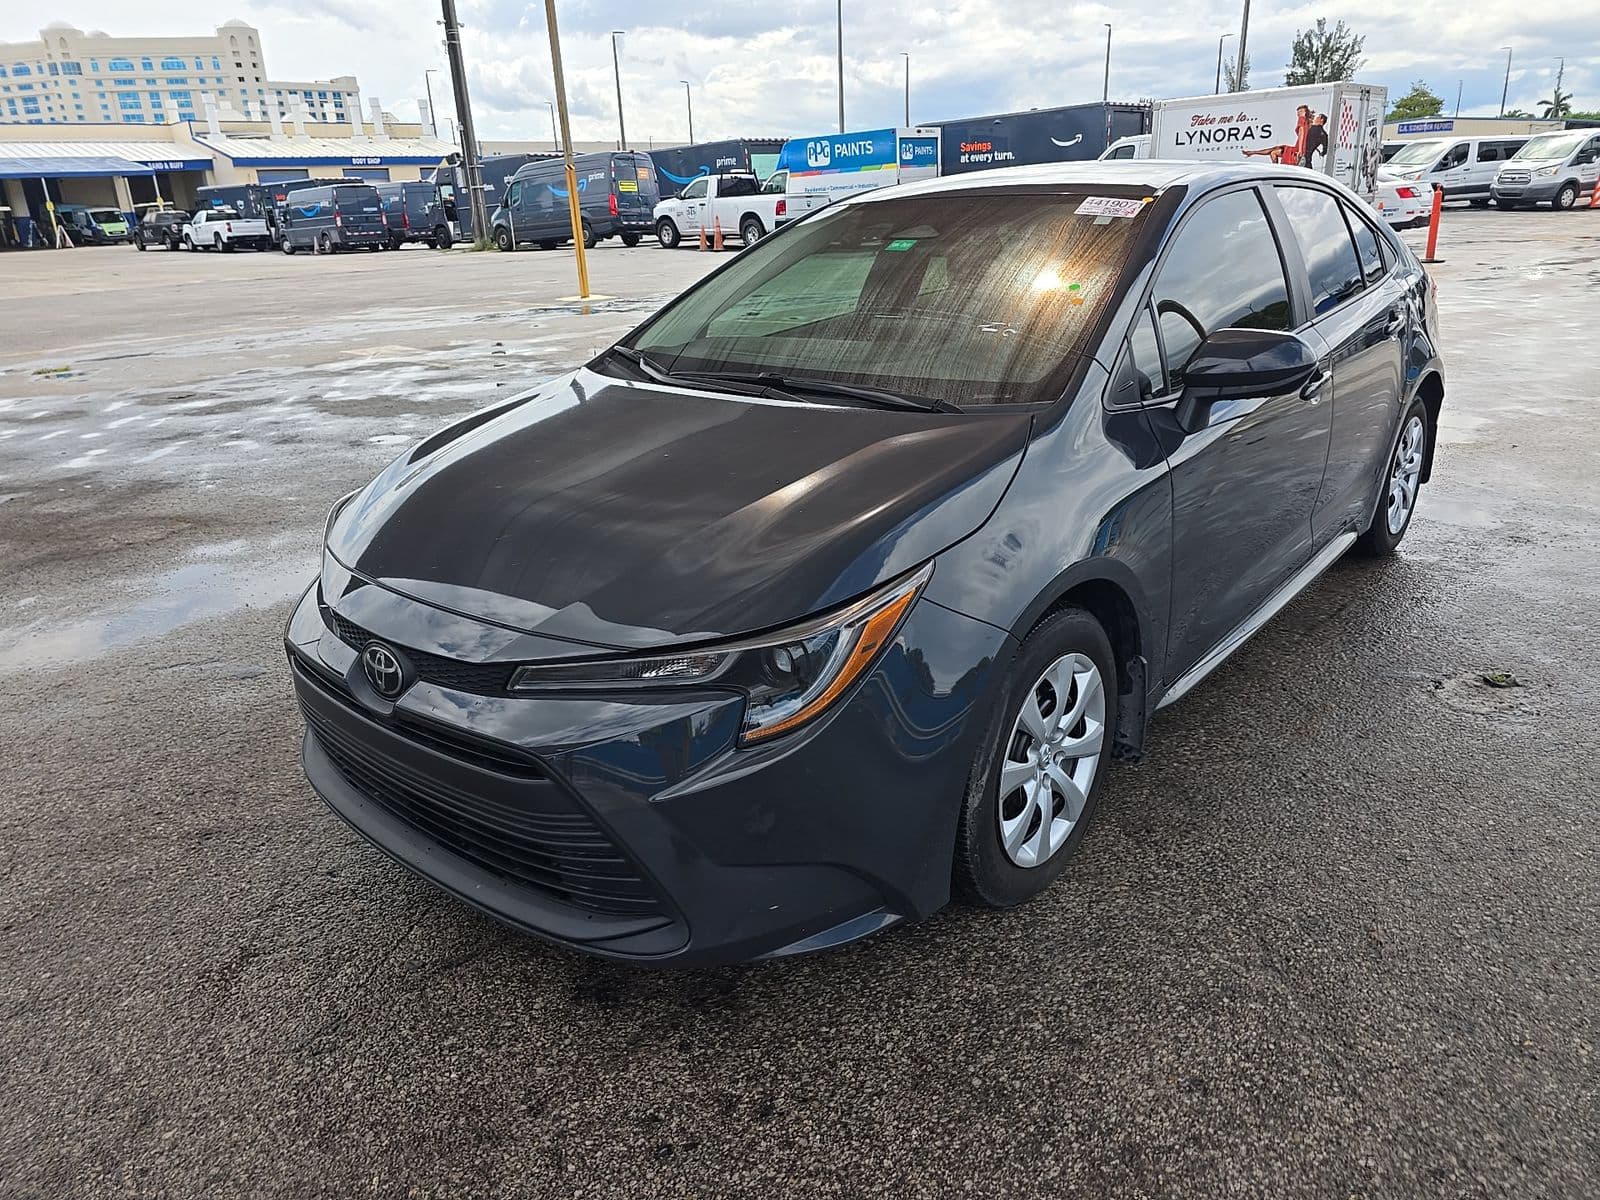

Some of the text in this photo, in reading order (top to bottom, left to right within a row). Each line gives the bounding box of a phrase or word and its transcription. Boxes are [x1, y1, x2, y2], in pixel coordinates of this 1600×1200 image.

[1190, 113, 1216, 127] Take
[1218, 115, 1234, 124] me
[1175, 124, 1272, 145] LYNORA'S
[807, 140, 874, 165] PPG PAINTS
[914, 146, 933, 156] PAINTS
[960, 141, 992, 152] Savings
[352, 157, 381, 165] BODY SHOP
[716, 155, 737, 168] prime
[960, 150, 1016, 163] at every turn.
[588, 172, 605, 182] prime
